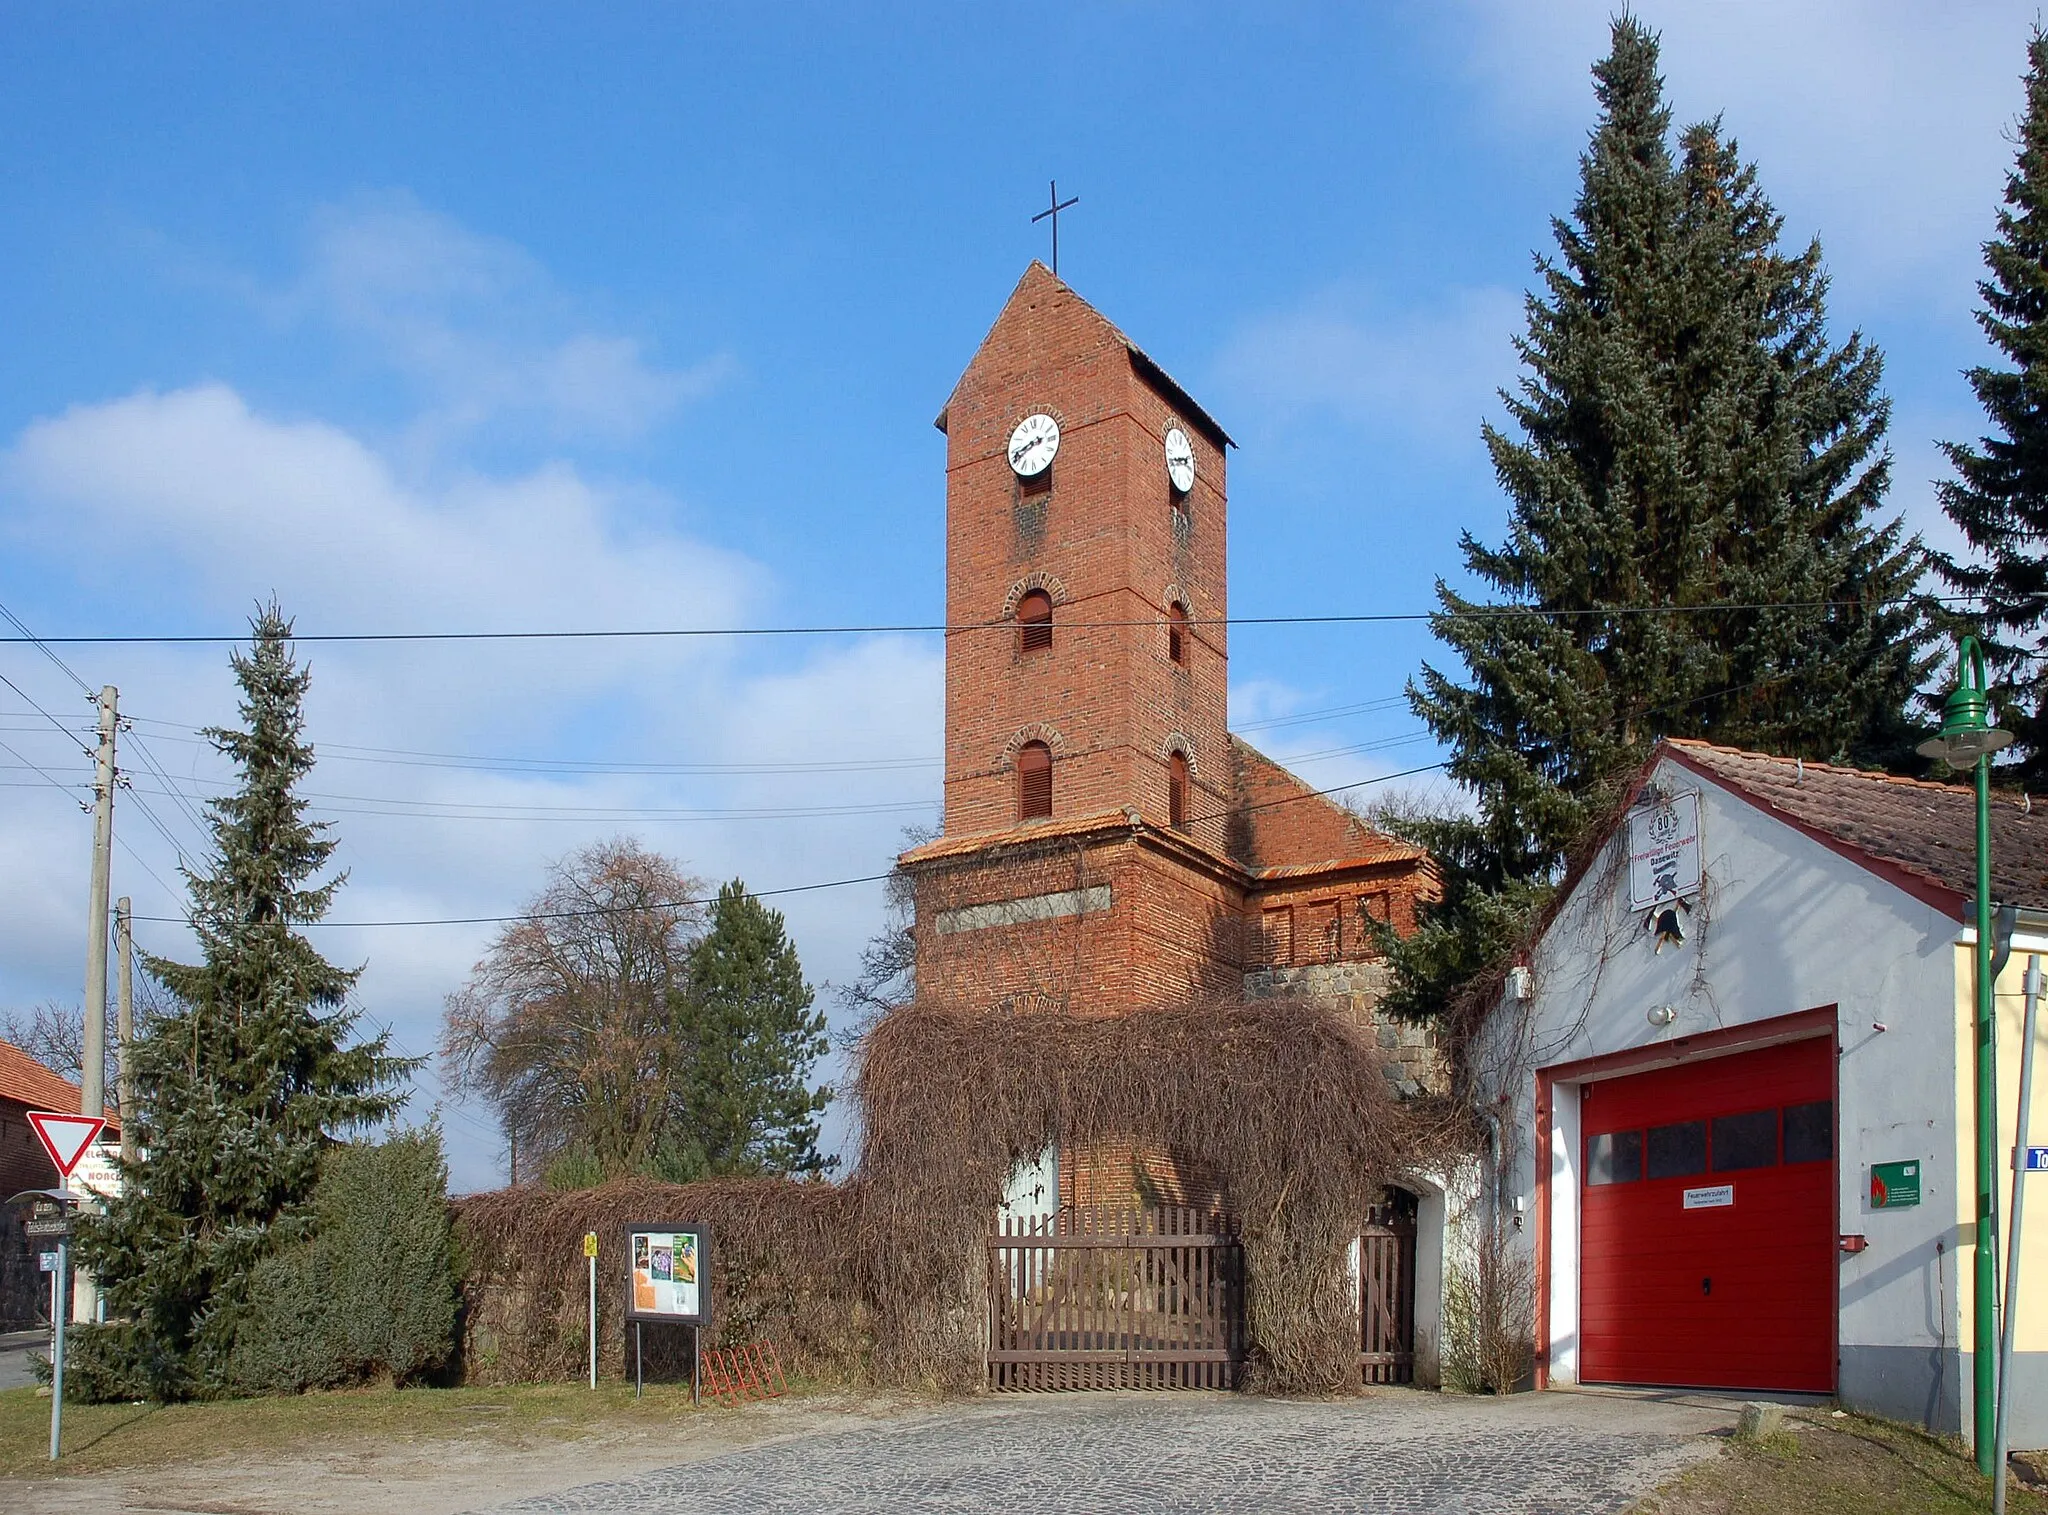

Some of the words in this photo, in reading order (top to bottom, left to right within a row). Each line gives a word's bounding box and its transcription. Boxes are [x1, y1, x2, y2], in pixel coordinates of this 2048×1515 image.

[1657, 815, 1669, 831] 80
[1634, 847, 1664, 863] Freiwillige
[1665, 835, 1696, 852] Feuerwehr
